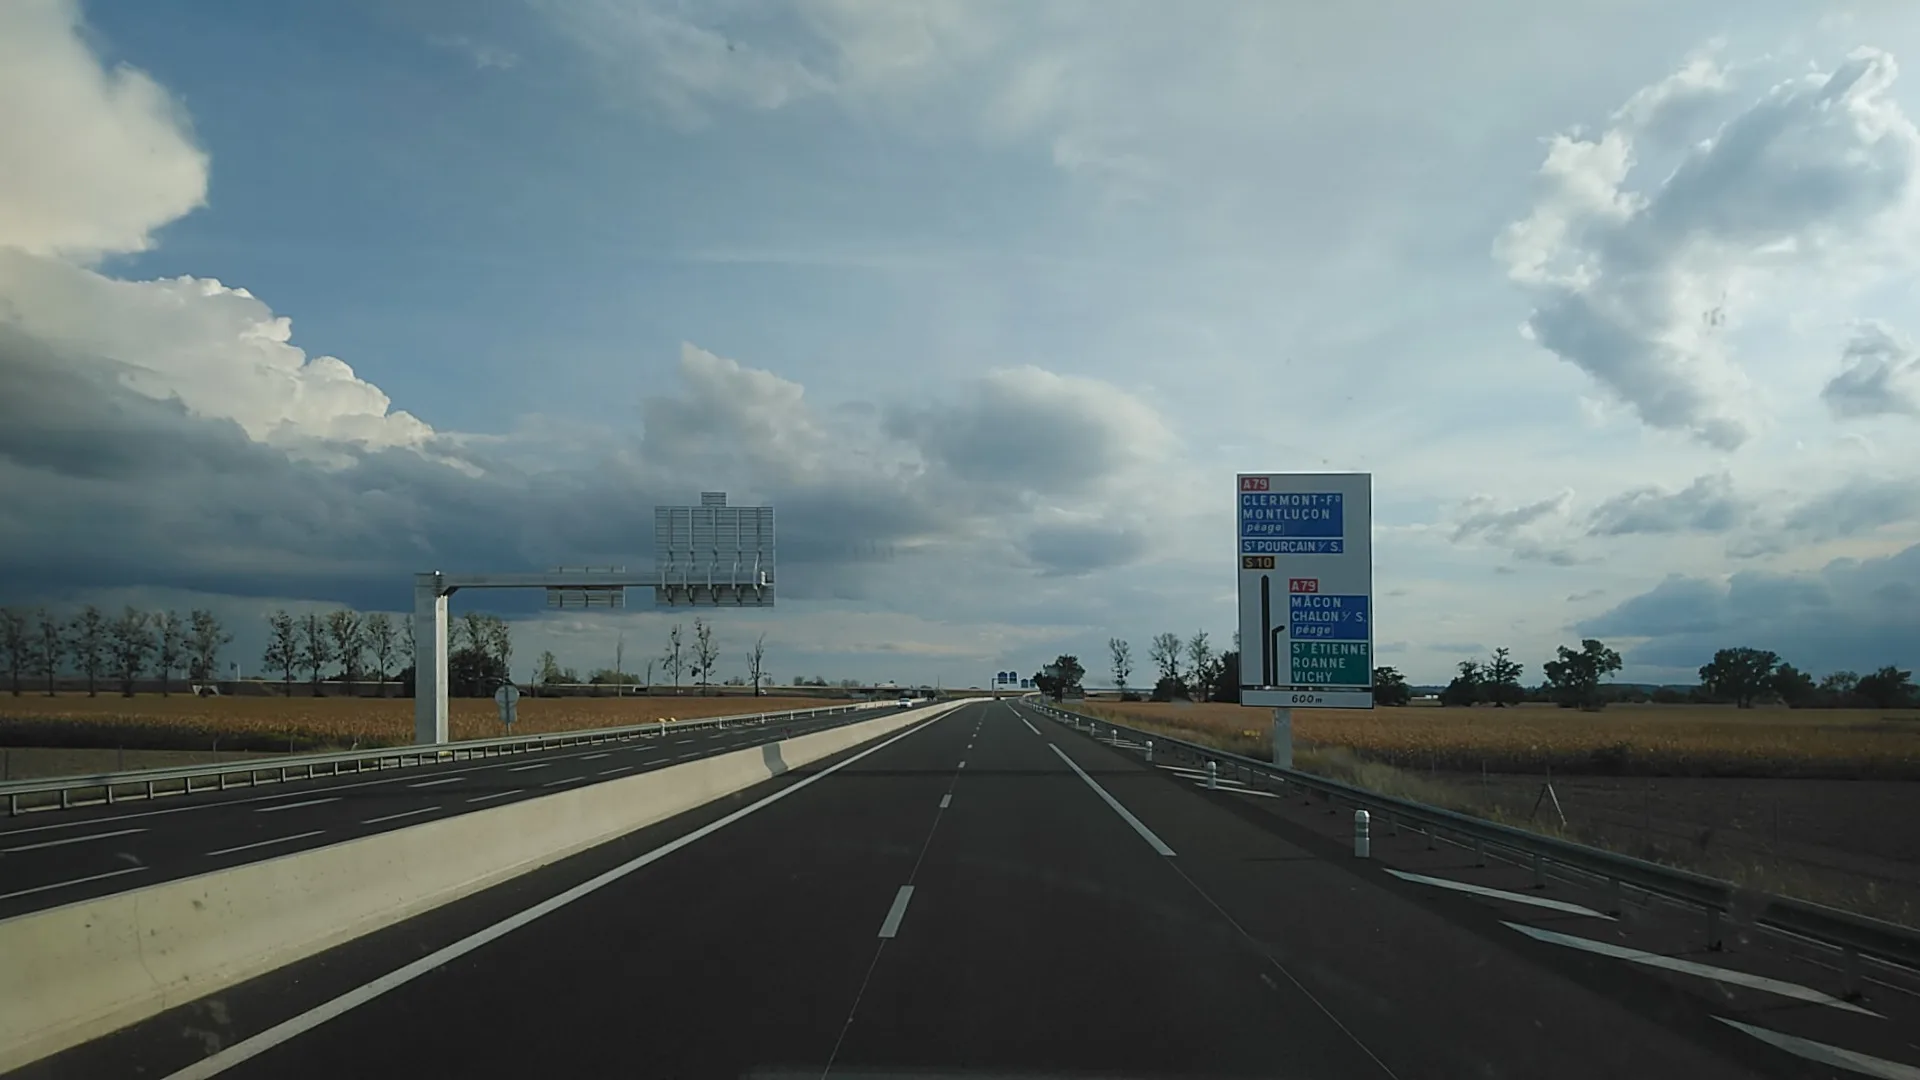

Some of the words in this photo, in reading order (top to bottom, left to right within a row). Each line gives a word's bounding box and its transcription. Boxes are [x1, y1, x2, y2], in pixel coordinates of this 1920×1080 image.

[1243, 479, 1268, 490] A79
[1243, 509, 1330, 520] MONTLUÇON
[1246, 523, 1282, 534] péage
[1257, 541, 1316, 552] POURÇAIN
[1291, 581, 1316, 591] A79
[1291, 597, 1341, 608] MÂCON
[1292, 611, 1339, 622] CHALON
[1295, 625, 1331, 636] péage
[1311, 642, 1367, 655] ÉTIENNE
[1293, 658, 1346, 668] ROANNE
[1293, 671, 1332, 682] VICHY
